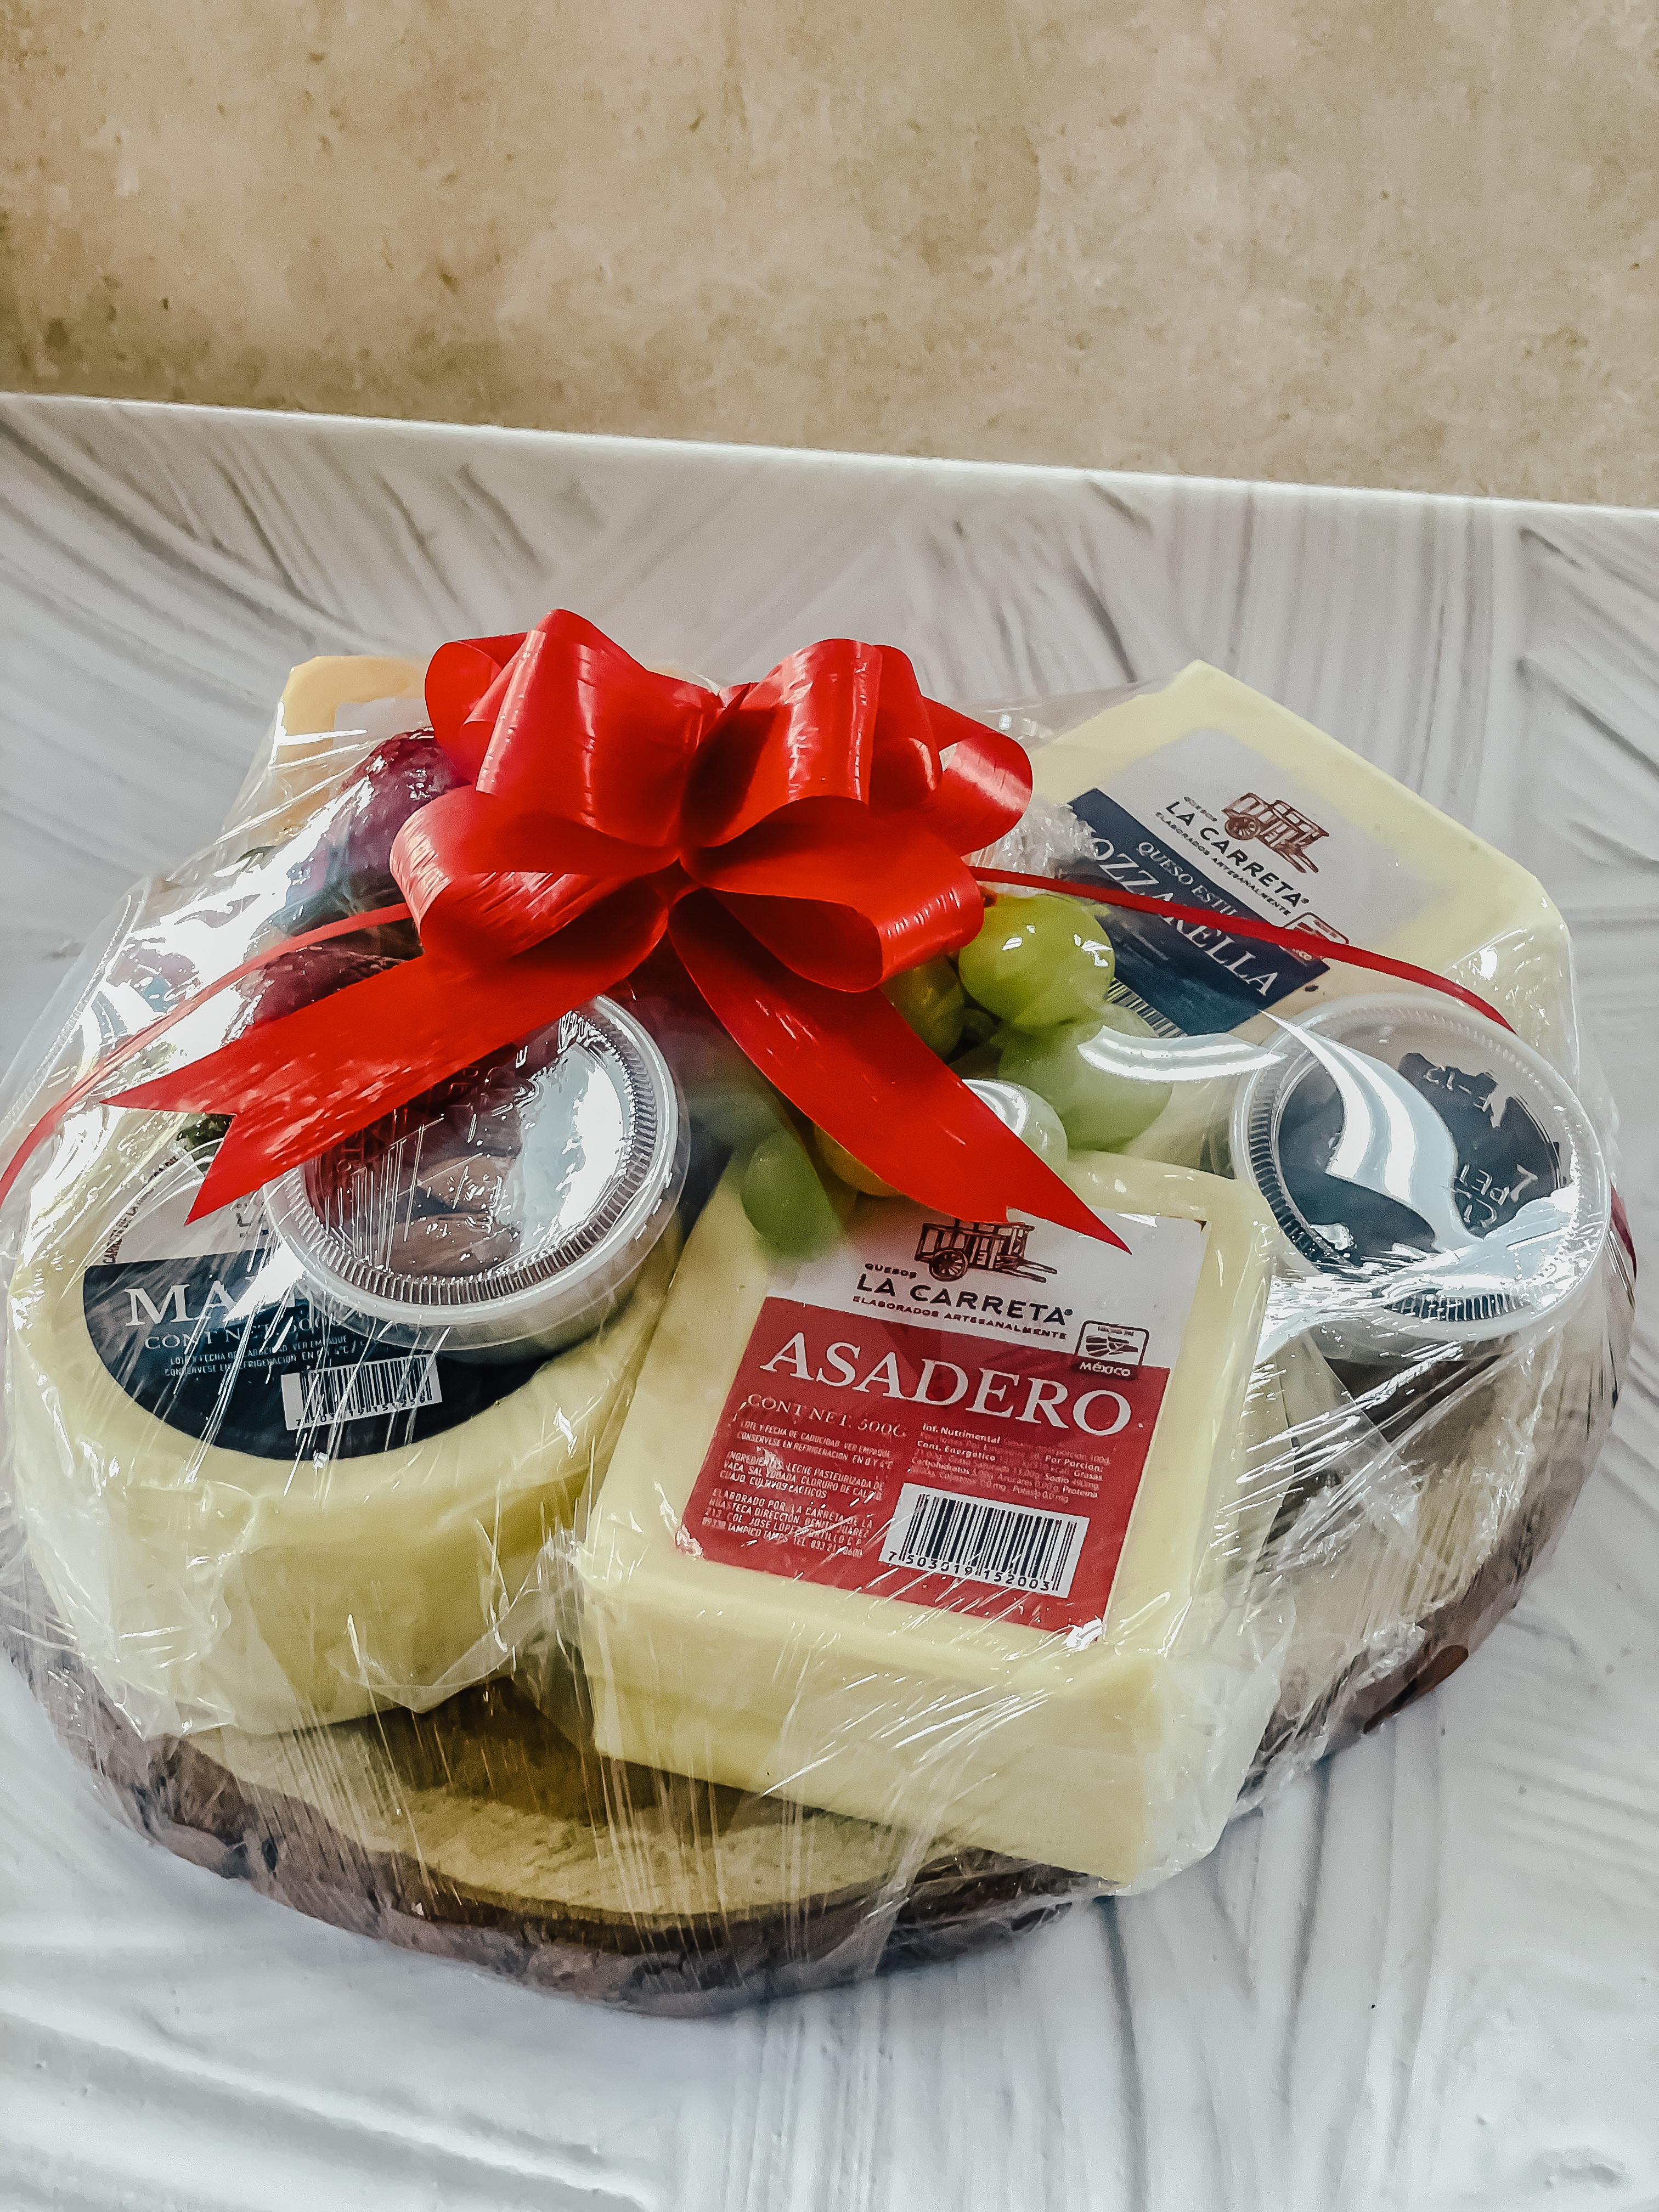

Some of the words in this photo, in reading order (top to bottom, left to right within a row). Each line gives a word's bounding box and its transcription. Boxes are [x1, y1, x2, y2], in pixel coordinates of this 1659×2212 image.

[1155, 811, 1210, 856] ELABORADOS
[1211, 857, 1291, 916] ARTESANALMENTE
[1166, 801, 1195, 826] LA
[1200, 827, 1302, 907] CARRETA
[1138, 842, 1193, 885] QUESO
[1191, 885, 1238, 916] ESTIL
[865, 1263, 918, 1279] QUESOS
[856, 1273, 896, 1297] LA
[910, 1285, 1066, 1326] CARRETA
[853, 1295, 939, 1317] ELABORADOS
[944, 1312, 1067, 1340] ARTESANALMENTE
[310, 1335, 348, 1348] EMAQUE
[760, 1331, 1132, 1436] ASADERO
[766, 1425, 788, 1436] FECHA
[788, 1429, 799, 1438] DE
[800, 1432, 840, 1448] CADUCIDAD
[843, 1441, 857, 1451] VER
[782, 1439, 792, 1449] EN
[1045, 1454, 1062, 1464] Por
[786, 1463, 812, 1476] LECHE
[873, 1481, 885, 1491] DE
[800, 1476, 839, 1491] CLORURO
[840, 1484, 851, 1494] DE
[768, 1498, 786, 1510] POR
